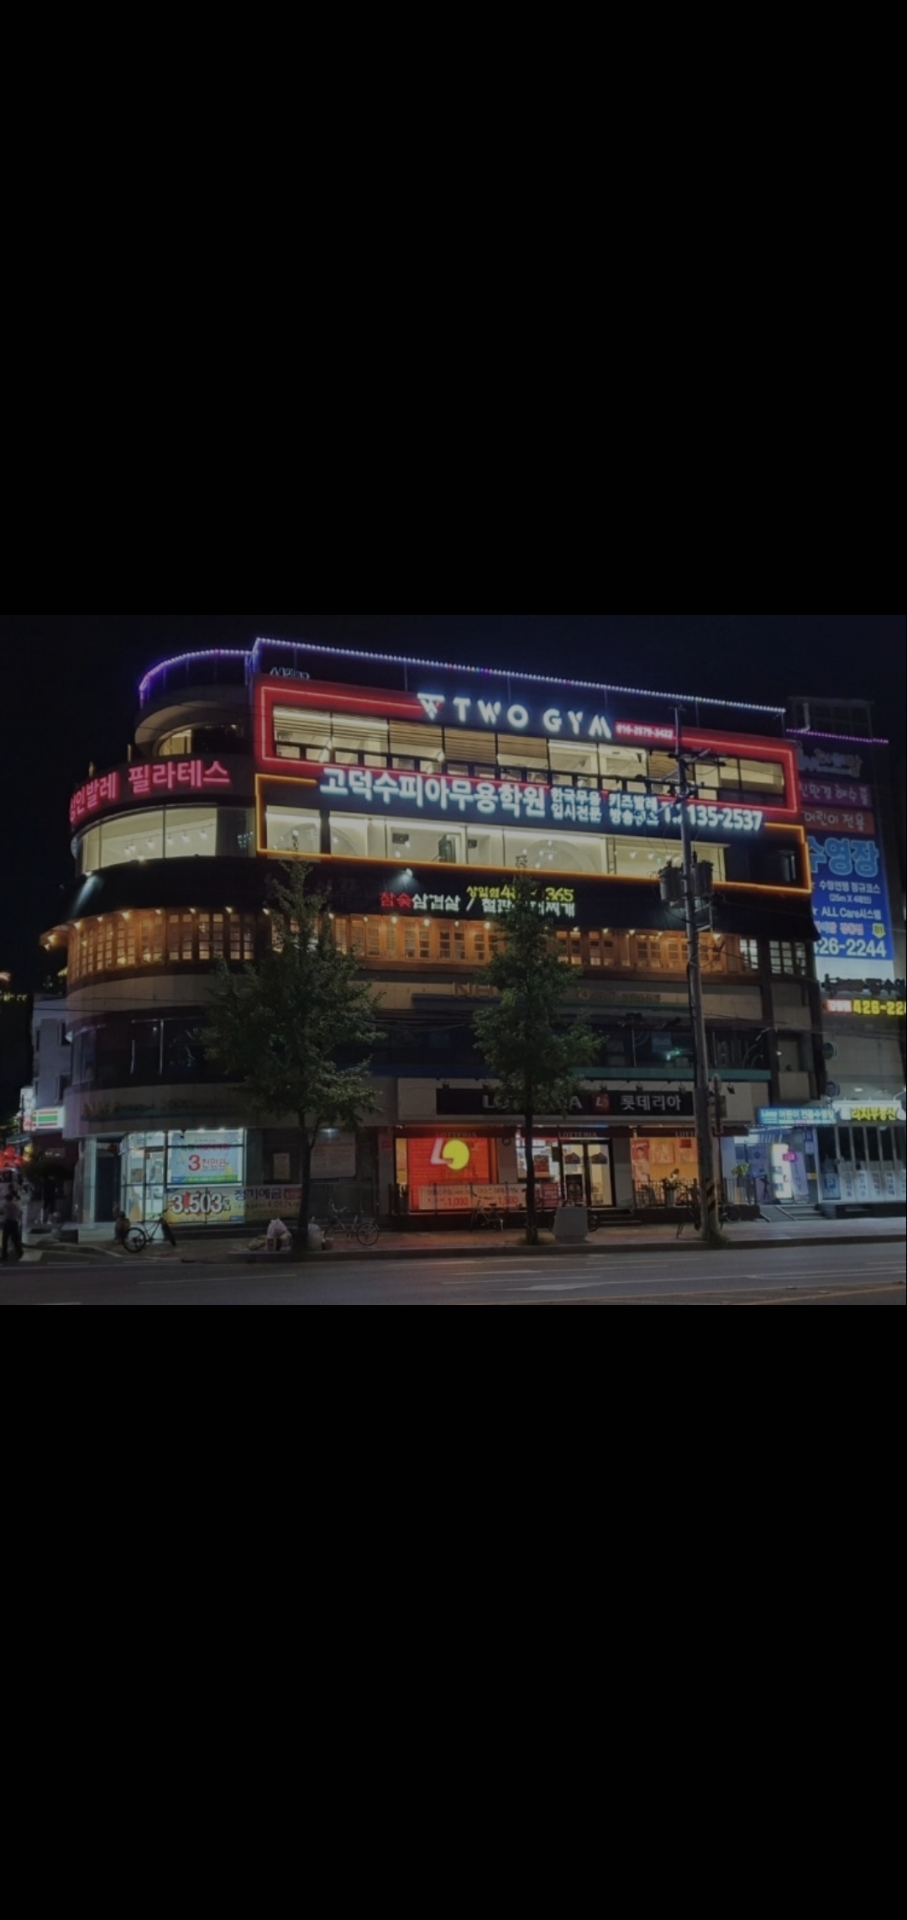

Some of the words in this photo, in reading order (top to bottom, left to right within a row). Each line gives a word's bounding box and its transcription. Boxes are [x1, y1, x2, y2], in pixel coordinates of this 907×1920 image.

[453, 697, 529, 728] TWO
[543, 708, 612, 740] GYM
[69, 771, 119, 822] 성인발레
[128, 760, 231, 795] 필라테스
[320, 768, 546, 819] 고덕수피아무용학원
[551, 787, 601, 807] 한국무용
[608, 792, 658, 812] 키즈발레
[804, 811, 839, 827] 어린이
[821, 906, 839, 918] ALL
[620, 1094, 682, 1112] 롯데리아
[234, 1188, 282, 1201] 정기예금
